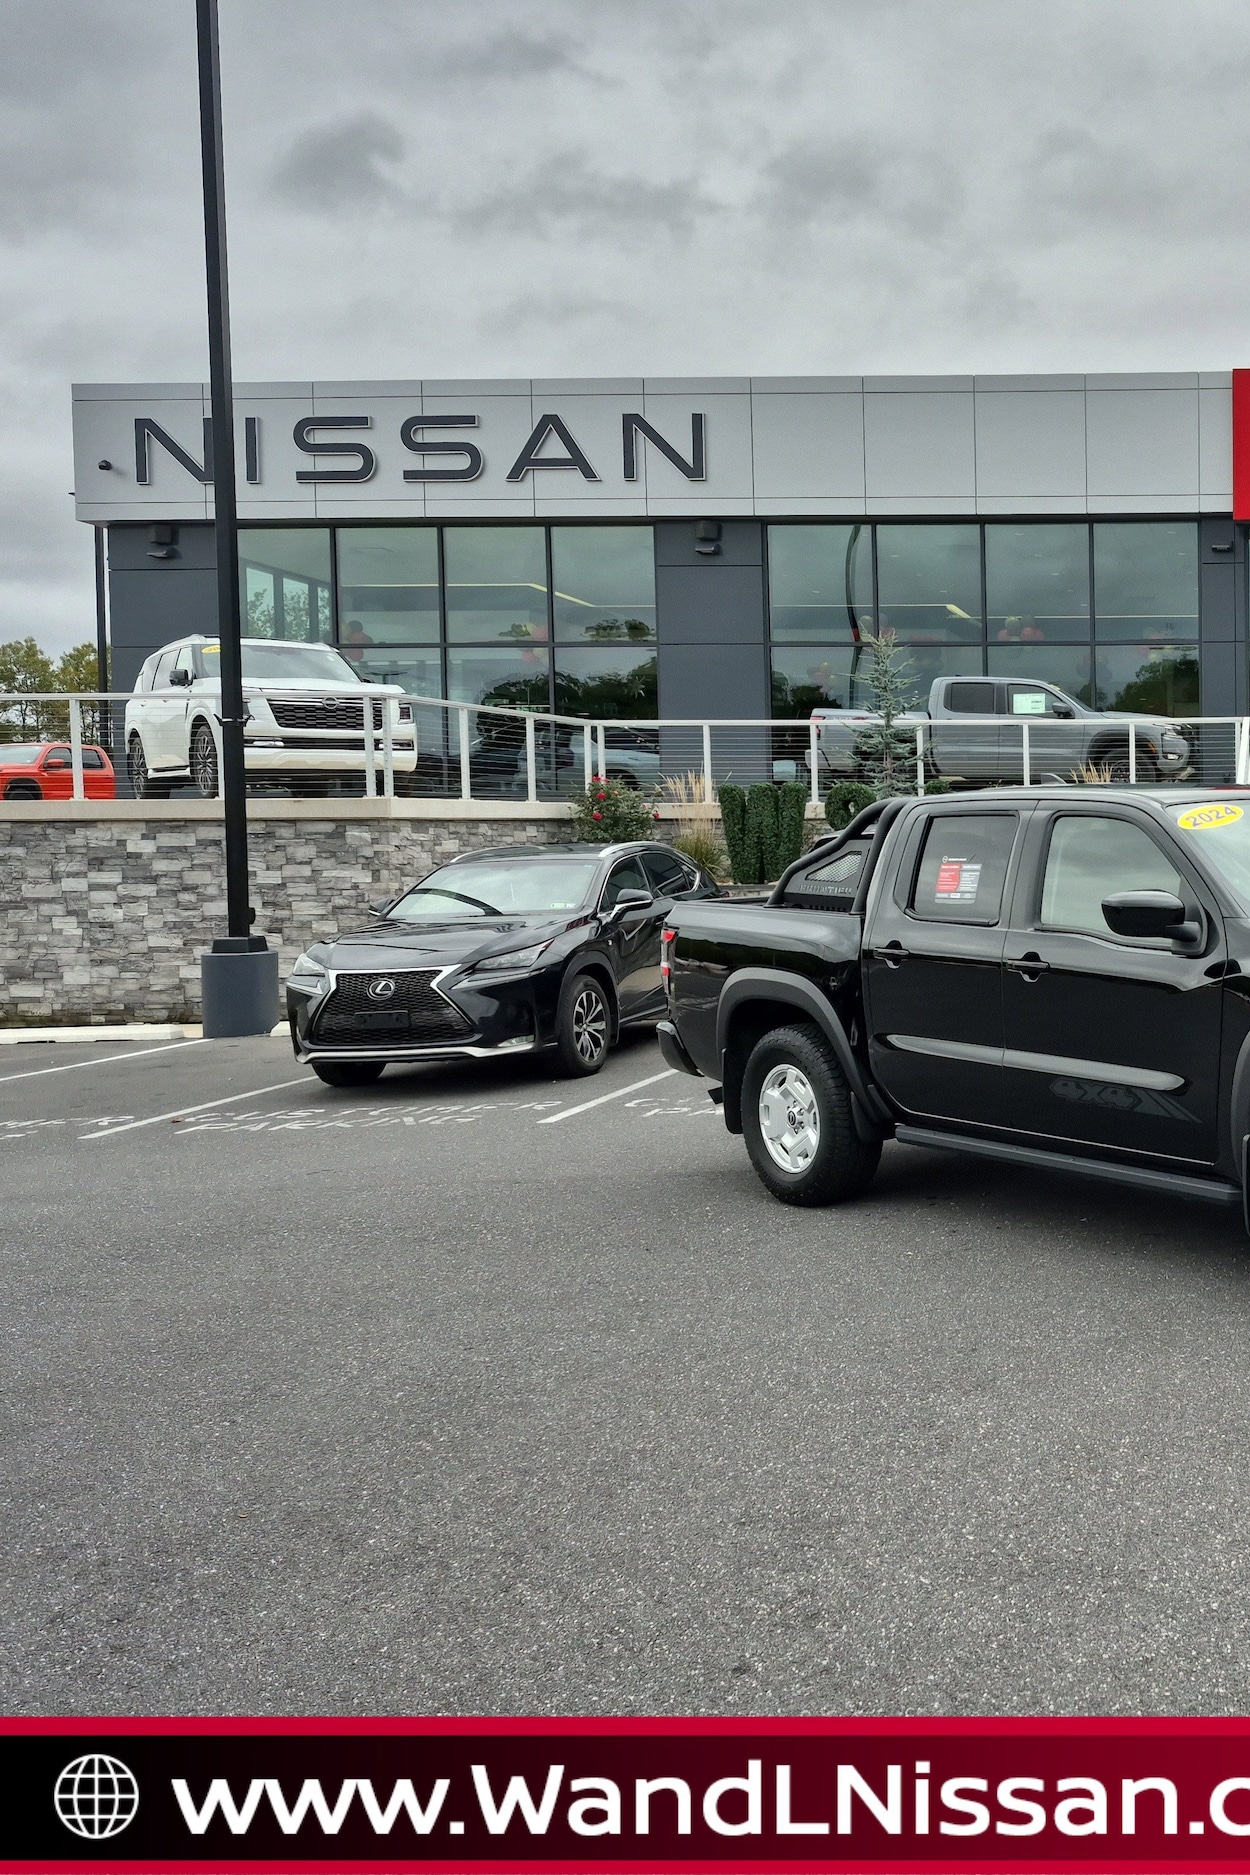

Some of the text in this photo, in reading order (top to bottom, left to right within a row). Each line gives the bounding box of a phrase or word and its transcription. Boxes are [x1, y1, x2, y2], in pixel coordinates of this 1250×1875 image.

[134, 412, 707, 485] NISSAN
[1186, 804, 1237, 828] 2024
[173, 1114, 484, 1135] PARKING
